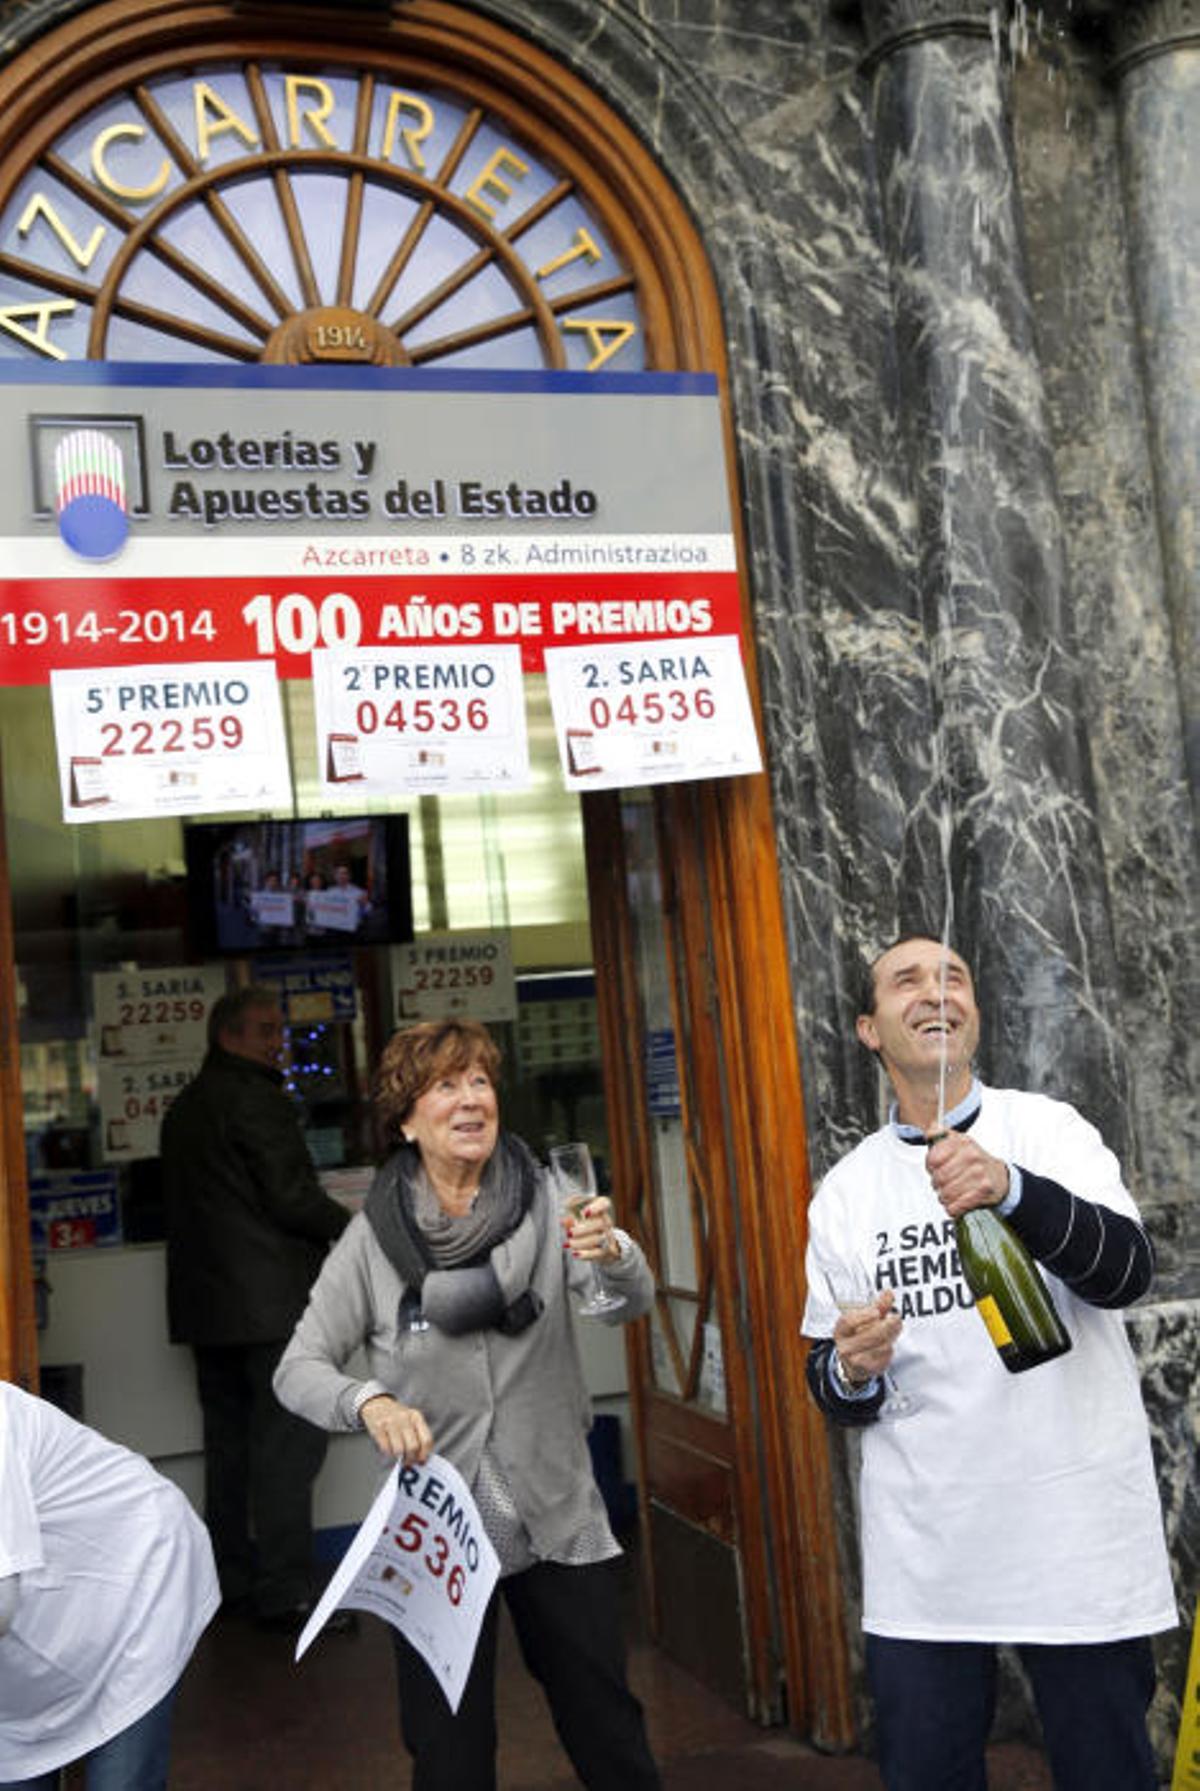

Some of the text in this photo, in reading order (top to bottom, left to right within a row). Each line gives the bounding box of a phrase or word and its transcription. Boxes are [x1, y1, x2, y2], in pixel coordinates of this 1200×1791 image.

[0, 75, 635, 371] AZCARRETA
[317, 325, 366, 347] 1914
[354, 440, 376, 478] y
[168, 480, 598, 526] Apuestas del Estado
[303, 543, 707, 566] Azcarreta 8 zk. Administrazioa
[1, 593, 713, 655] 1914-2014 100 AÑOS DE PREMIOS
[374, 664, 495, 690] PREMIO
[582, 656, 711, 688] 2. SARIA
[119, 680, 249, 711] PREMIO
[590, 689, 715, 728] 04536
[356, 699, 489, 734] 04536
[101, 715, 243, 756] 22259
[425, 943, 498, 964] PREMIO
[142, 978, 205, 998] SARIA
[413, 965, 494, 990] 22259
[119, 1001, 205, 1026] 22259
[890, 1284, 976, 1320] ALDU
[383, 1513, 466, 1607] 536
